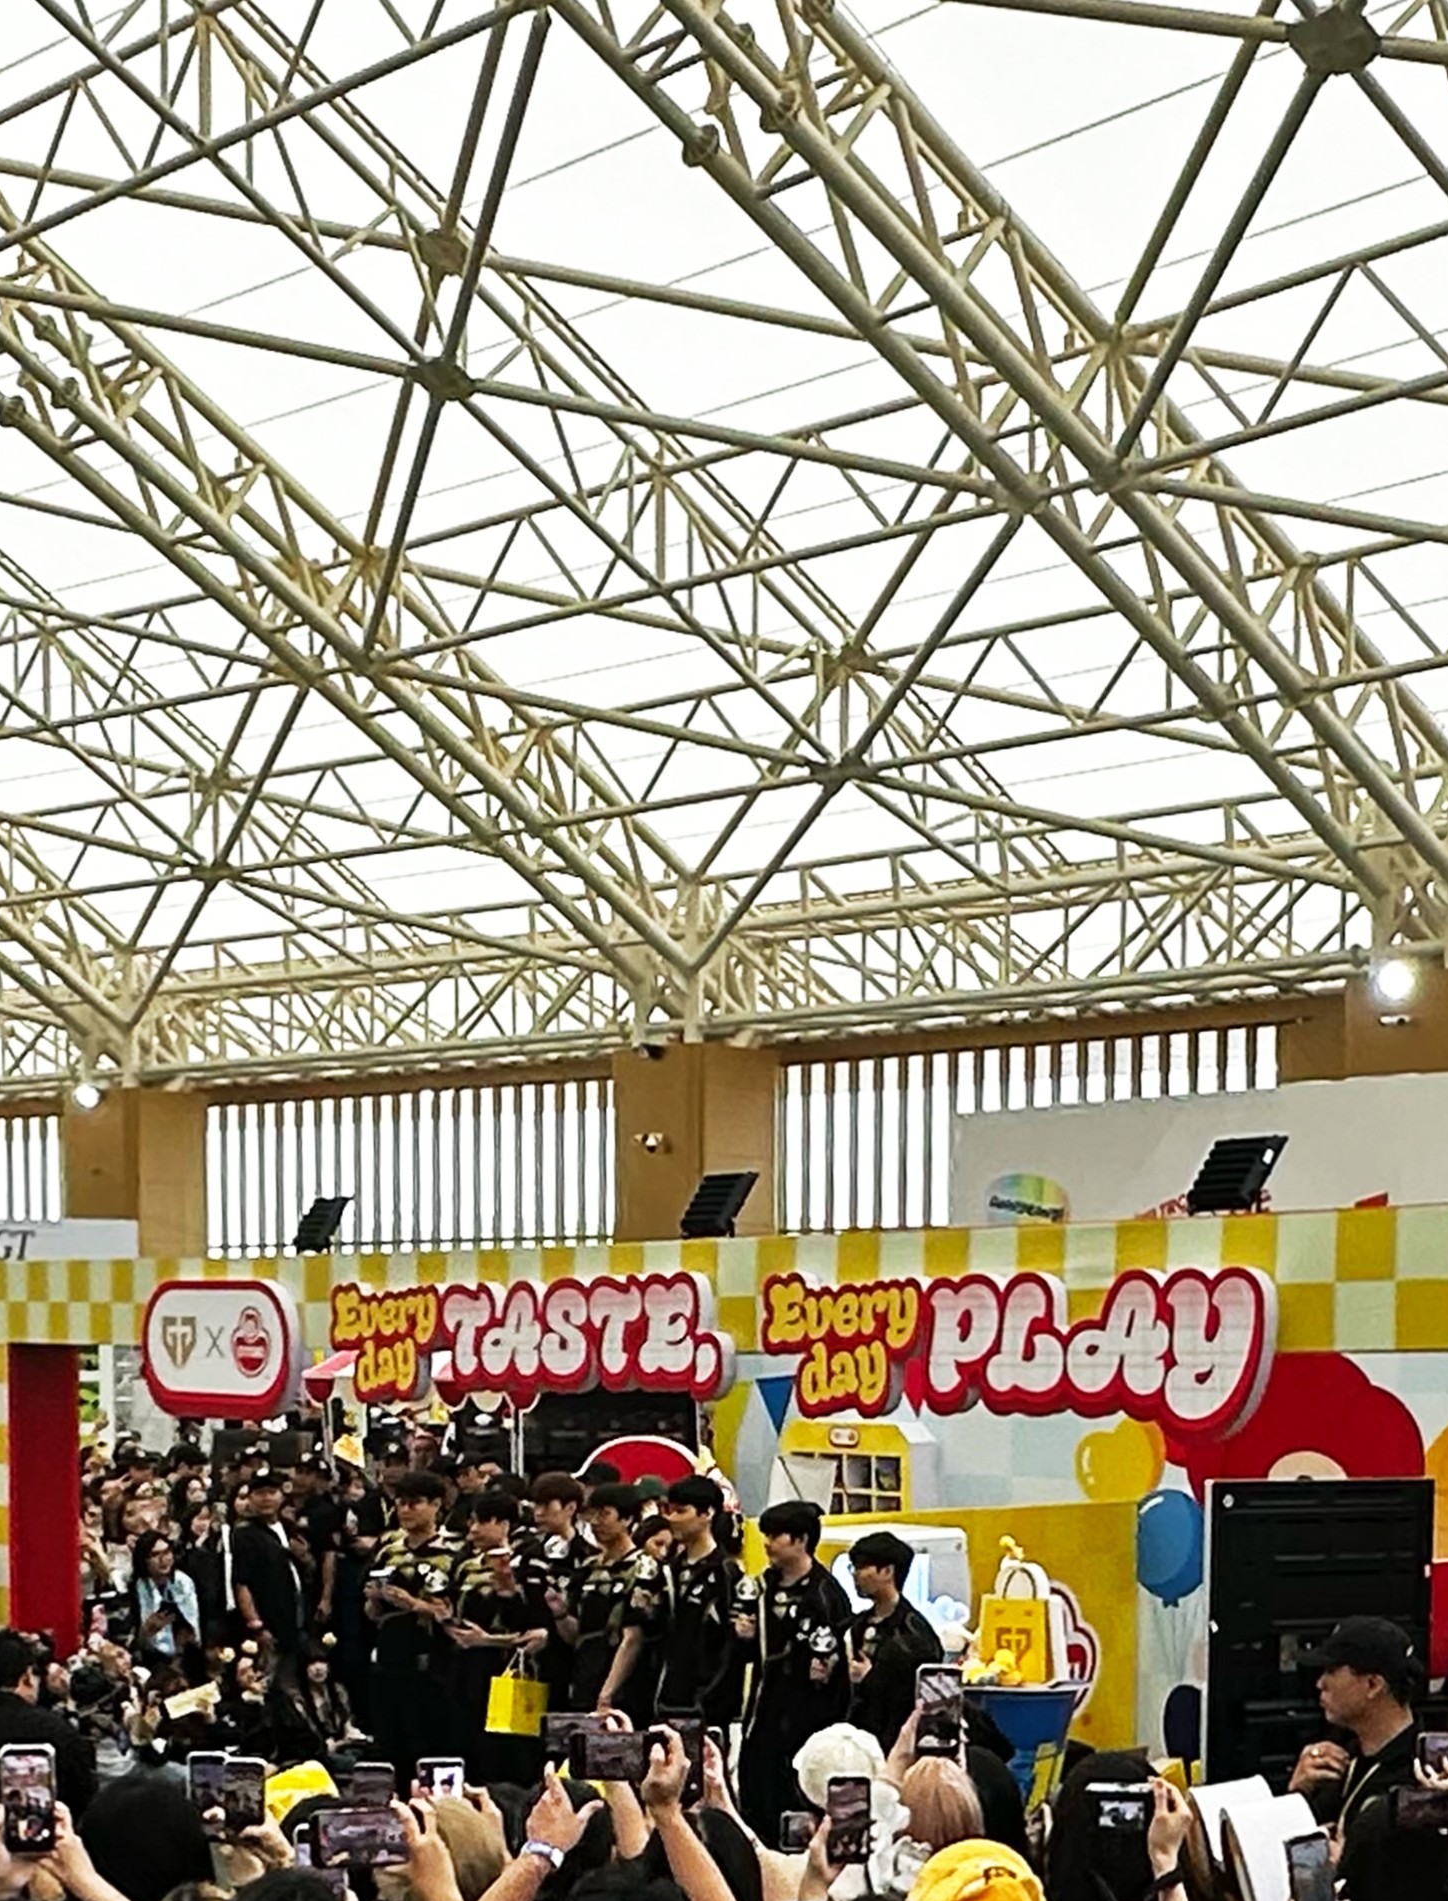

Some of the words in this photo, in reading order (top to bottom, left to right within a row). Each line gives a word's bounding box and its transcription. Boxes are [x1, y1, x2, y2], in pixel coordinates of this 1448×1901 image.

[332, 1290, 438, 1345] Every
[767, 1281, 919, 1347] Every
[356, 1336, 418, 1393] day
[802, 1340, 884, 1403] day
[928, 1277, 1251, 1421] PLAY
